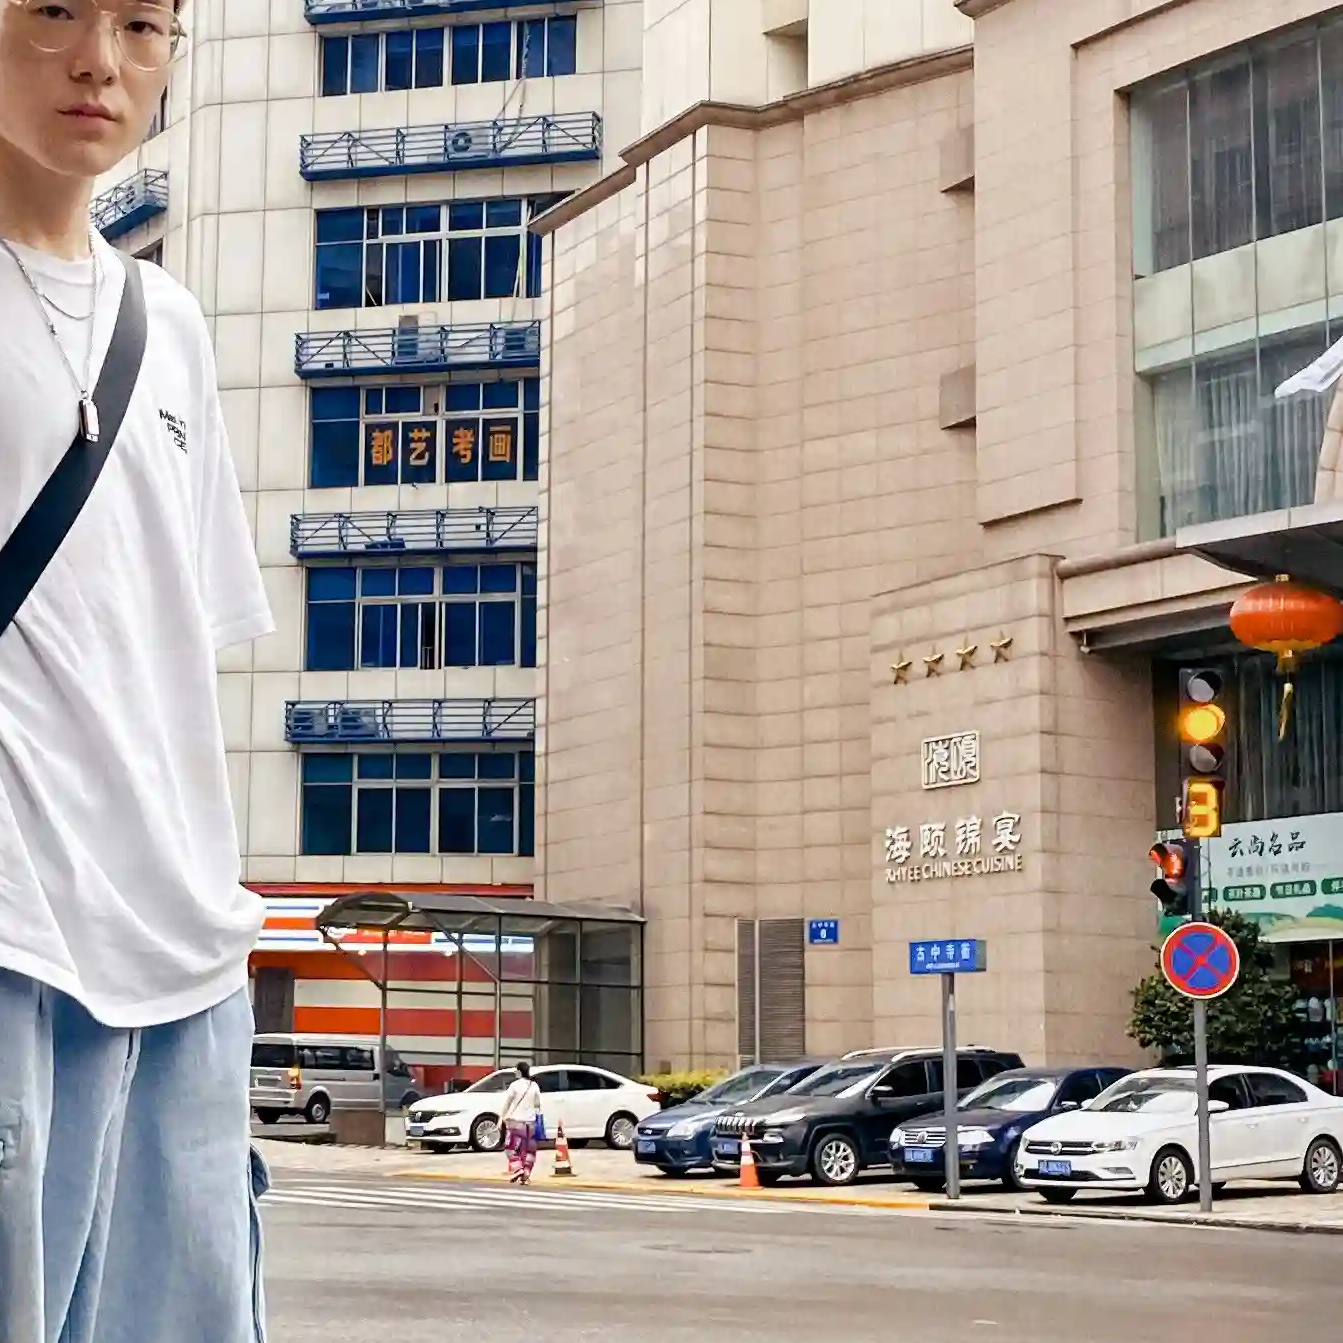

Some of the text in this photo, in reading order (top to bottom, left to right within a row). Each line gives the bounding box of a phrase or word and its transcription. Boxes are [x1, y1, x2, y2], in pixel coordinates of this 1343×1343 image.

[370, 425, 511, 466] 都艺考画
[922, 858, 972, 879] CHINESE
[973, 854, 1023, 874] CUISINE
